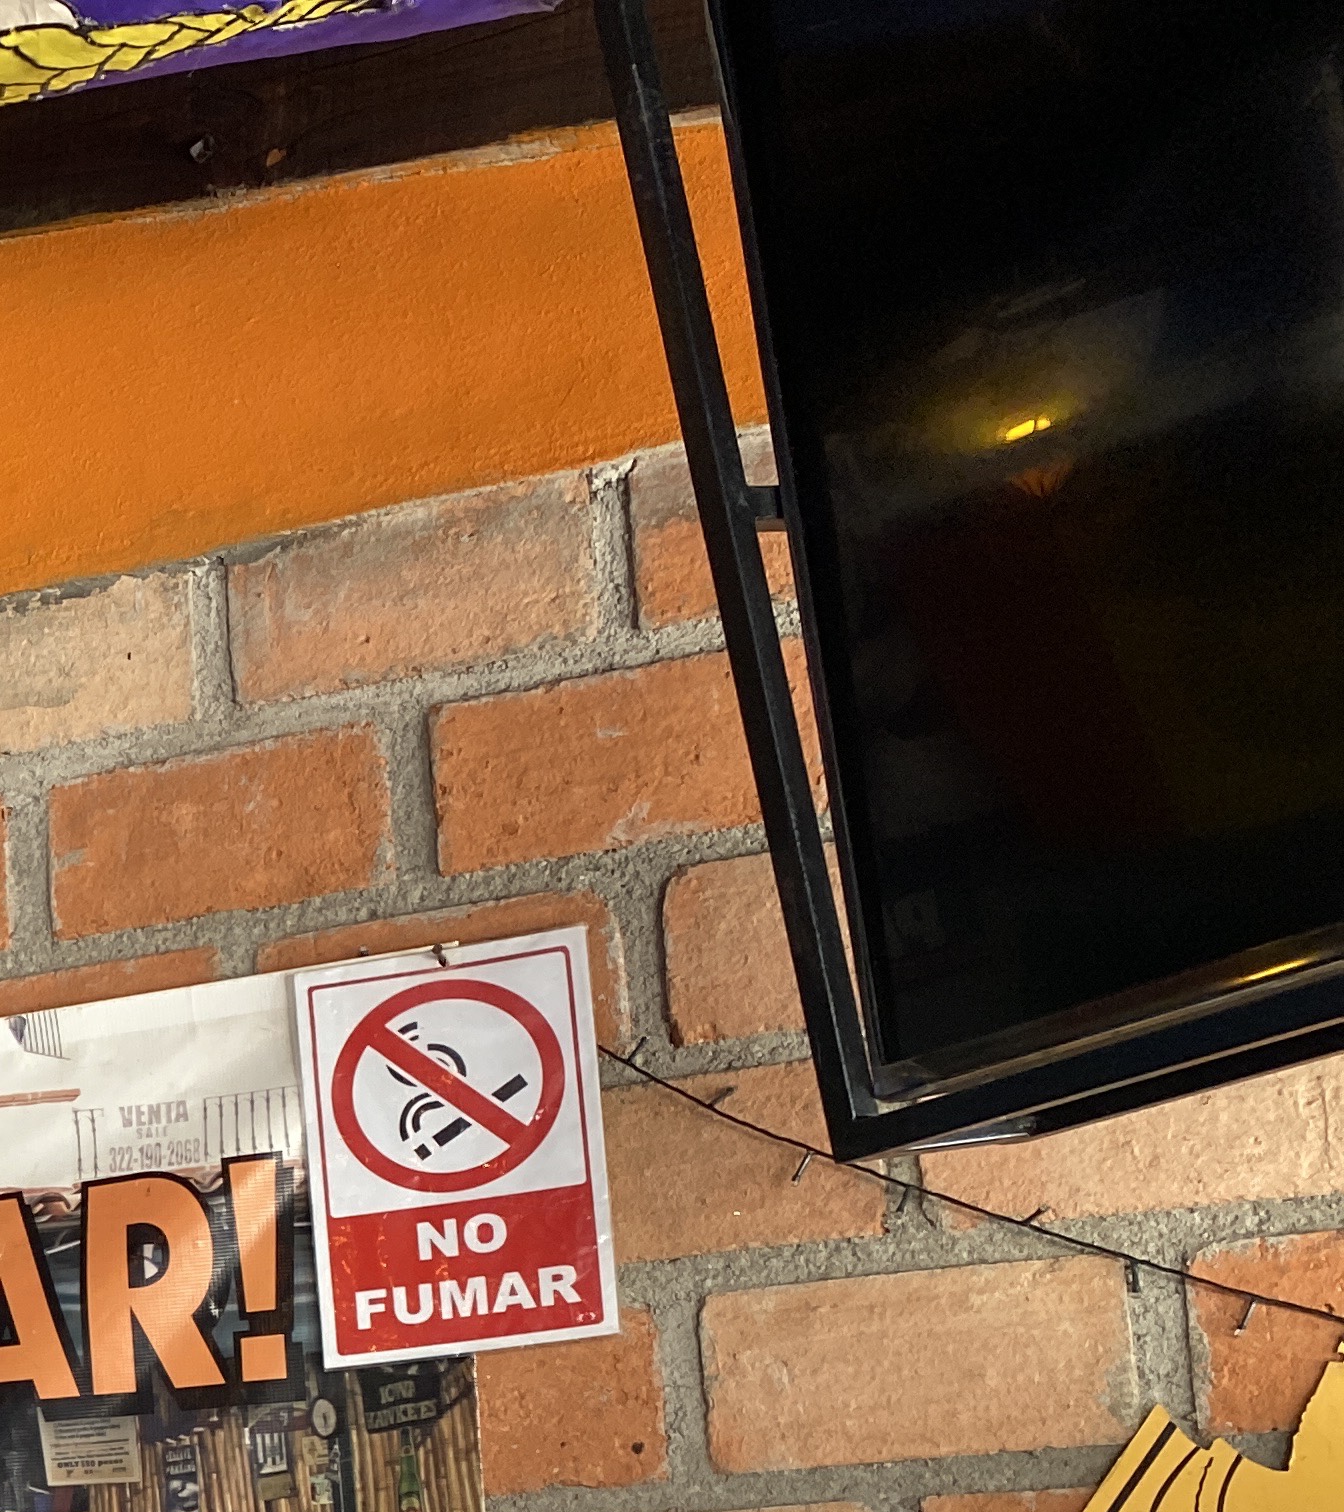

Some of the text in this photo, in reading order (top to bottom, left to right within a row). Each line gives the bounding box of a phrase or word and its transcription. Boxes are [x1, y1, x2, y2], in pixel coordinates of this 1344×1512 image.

[119, 1100, 188, 1128] VENTA
[416, 1212, 507, 1261] NO
[355, 1264, 582, 1330] FUMAR
